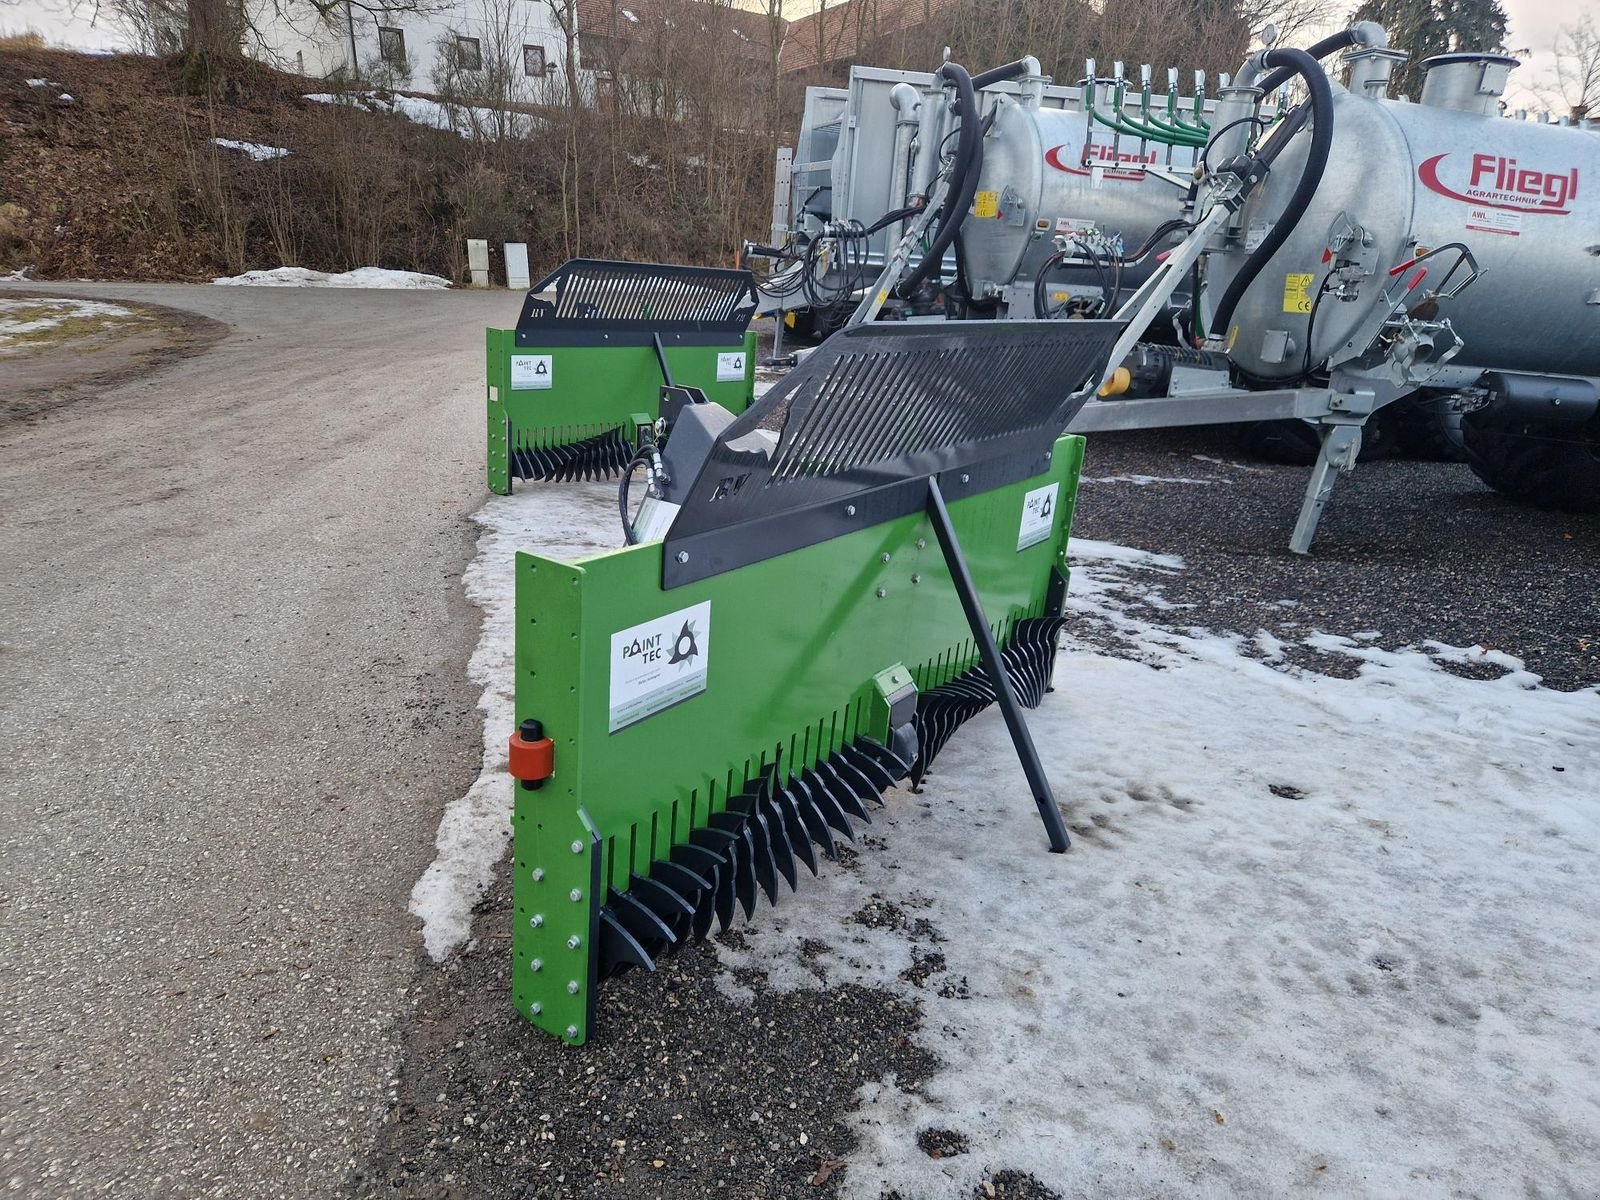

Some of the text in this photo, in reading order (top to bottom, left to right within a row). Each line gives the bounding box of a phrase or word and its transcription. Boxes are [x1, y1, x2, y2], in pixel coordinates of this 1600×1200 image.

[1470, 153, 1578, 208] Fliegl
[1466, 189, 1540, 206] AGRARTECHNIK
[642, 647, 662, 664] TEC
